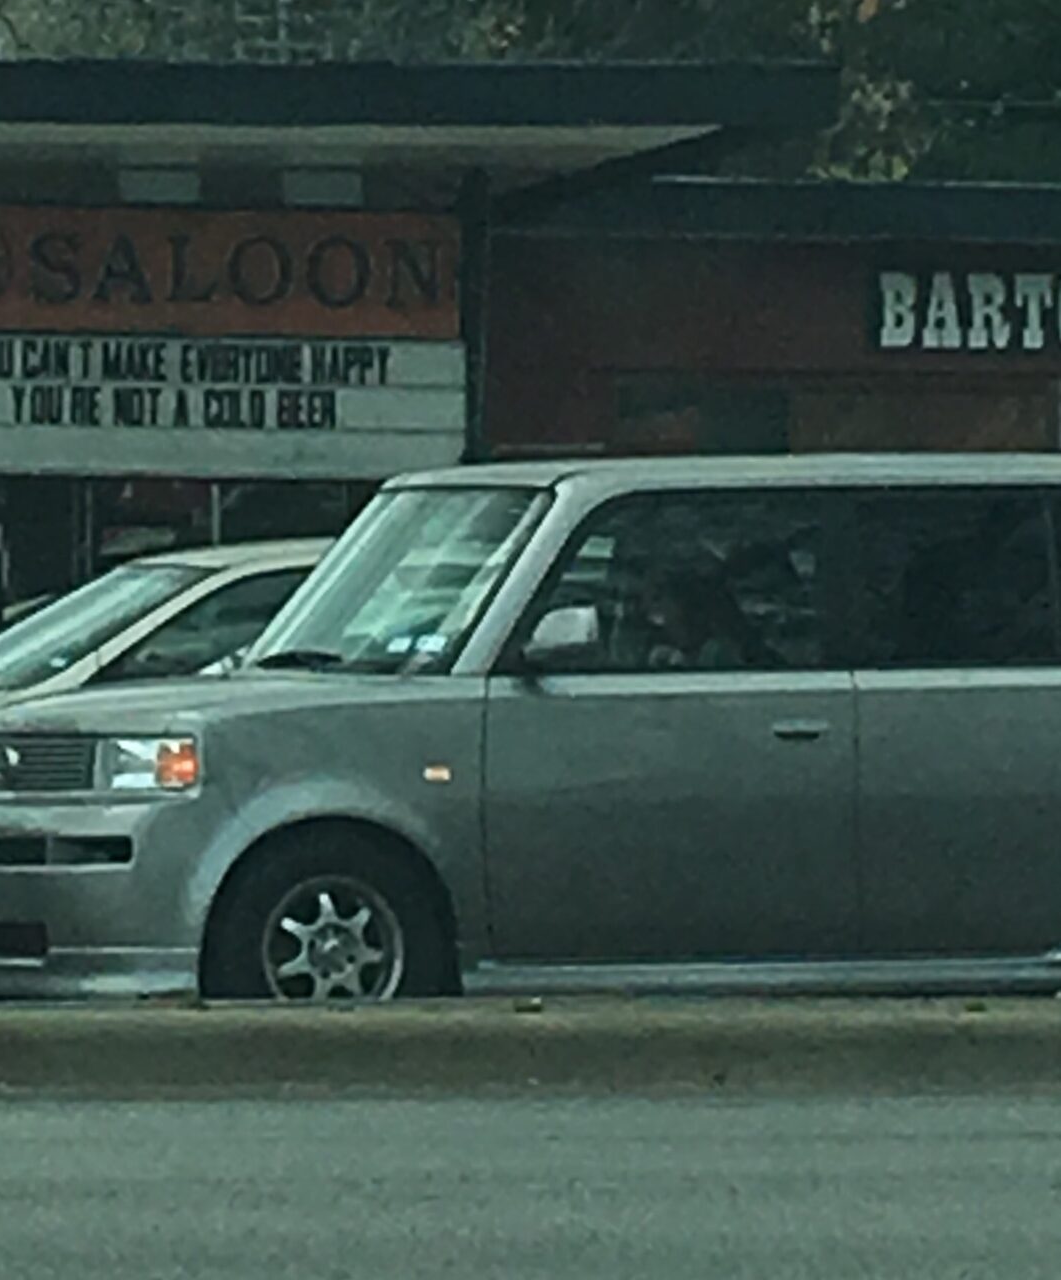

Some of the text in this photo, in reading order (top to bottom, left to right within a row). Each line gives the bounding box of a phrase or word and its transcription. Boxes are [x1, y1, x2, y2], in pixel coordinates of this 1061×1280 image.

[29, 232, 443, 310] SALOON
[879, 272, 1061, 349] BART
[101, 341, 168, 383] MAKE
[309, 344, 391, 386] HAPPY
[112, 387, 162, 427] NOT
[172, 388, 189, 428] A
[202, 388, 267, 429] COLD
[275, 389, 337, 430] BEER
